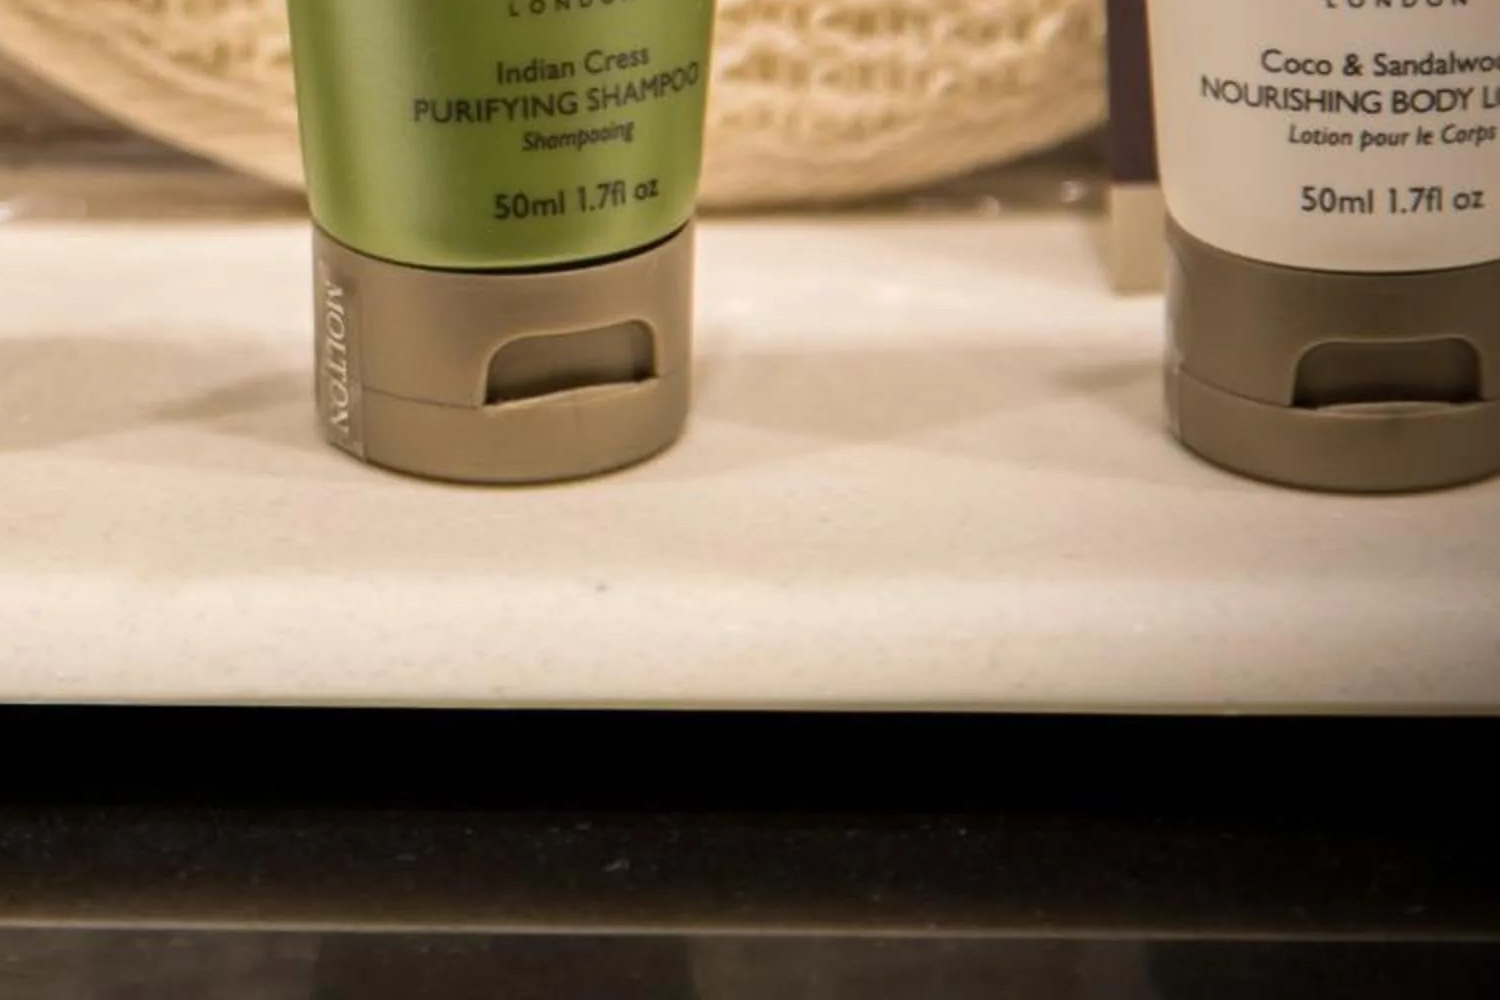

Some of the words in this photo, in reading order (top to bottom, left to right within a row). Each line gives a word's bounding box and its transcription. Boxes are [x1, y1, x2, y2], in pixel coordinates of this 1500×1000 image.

[496, 60, 575, 85] Indian
[584, 47, 650, 75] Cress
[1260, 48, 1333, 76] Coco
[1343, 52, 1364, 77] &
[414, 90, 579, 123] PURIFYING
[587, 62, 699, 112] SHAMPOO
[1201, 74, 1383, 114] NOURISHING
[1391, 86, 1476, 114] BODY
[521, 121, 635, 152] Shampooing
[1288, 125, 1353, 147] Lotion
[1360, 129, 1409, 152] pour
[1415, 125, 1434, 145] le
[1441, 123, 1498, 147] Corps
[493, 190, 566, 220] 50ml
[577, 182, 627, 214] 1.7fl
[634, 178, 660, 198] oz
[1300, 186, 1374, 214] 50ml
[1388, 185, 1444, 214] 1.7fl
[1451, 190, 1485, 210] oz
[325, 280, 350, 434] MOLTON
